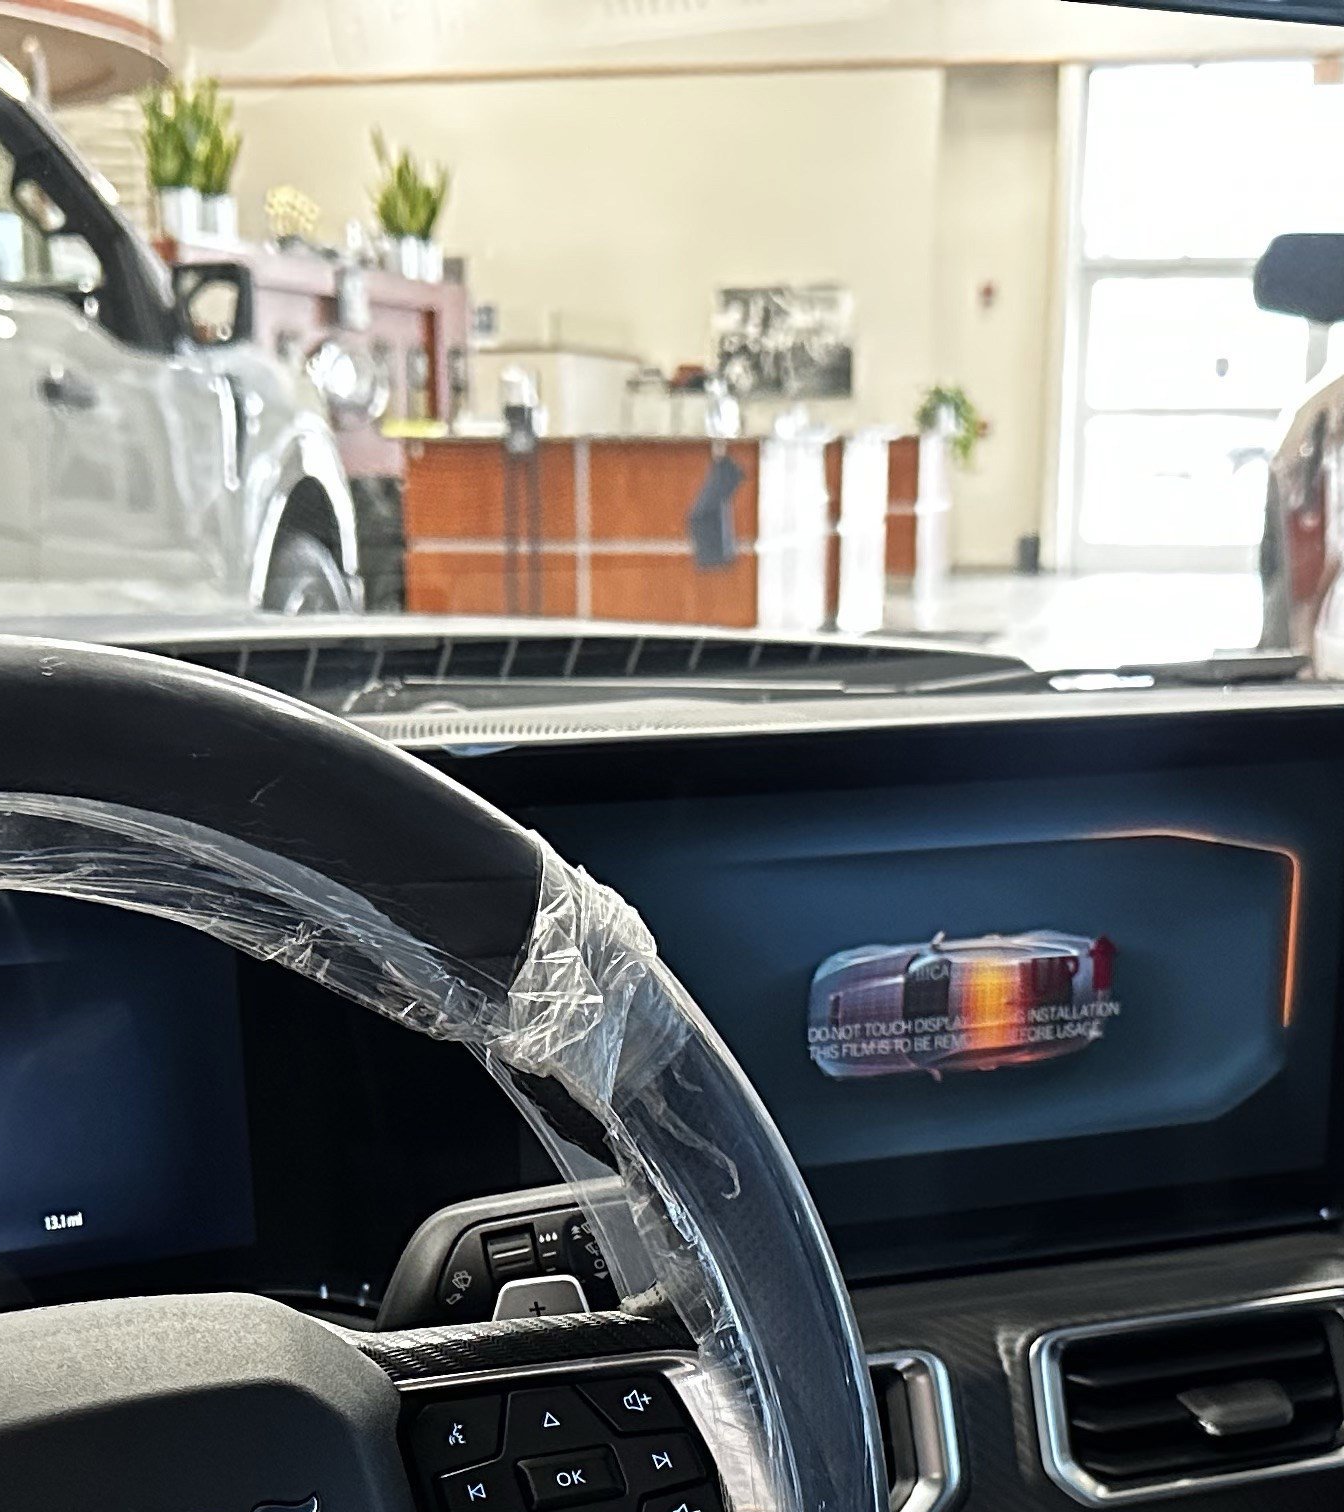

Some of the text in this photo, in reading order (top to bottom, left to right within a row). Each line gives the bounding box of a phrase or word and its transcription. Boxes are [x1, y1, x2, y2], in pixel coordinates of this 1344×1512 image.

[832, 1023, 861, 1040] NOT
[864, 1020, 912, 1037] TOUCH
[1027, 1001, 1120, 1023] INSTALLATION
[914, 1035, 932, 1052] BE
[44, 1214, 66, 1230] 13.1
[556, 1469, 587, 1487] OK
